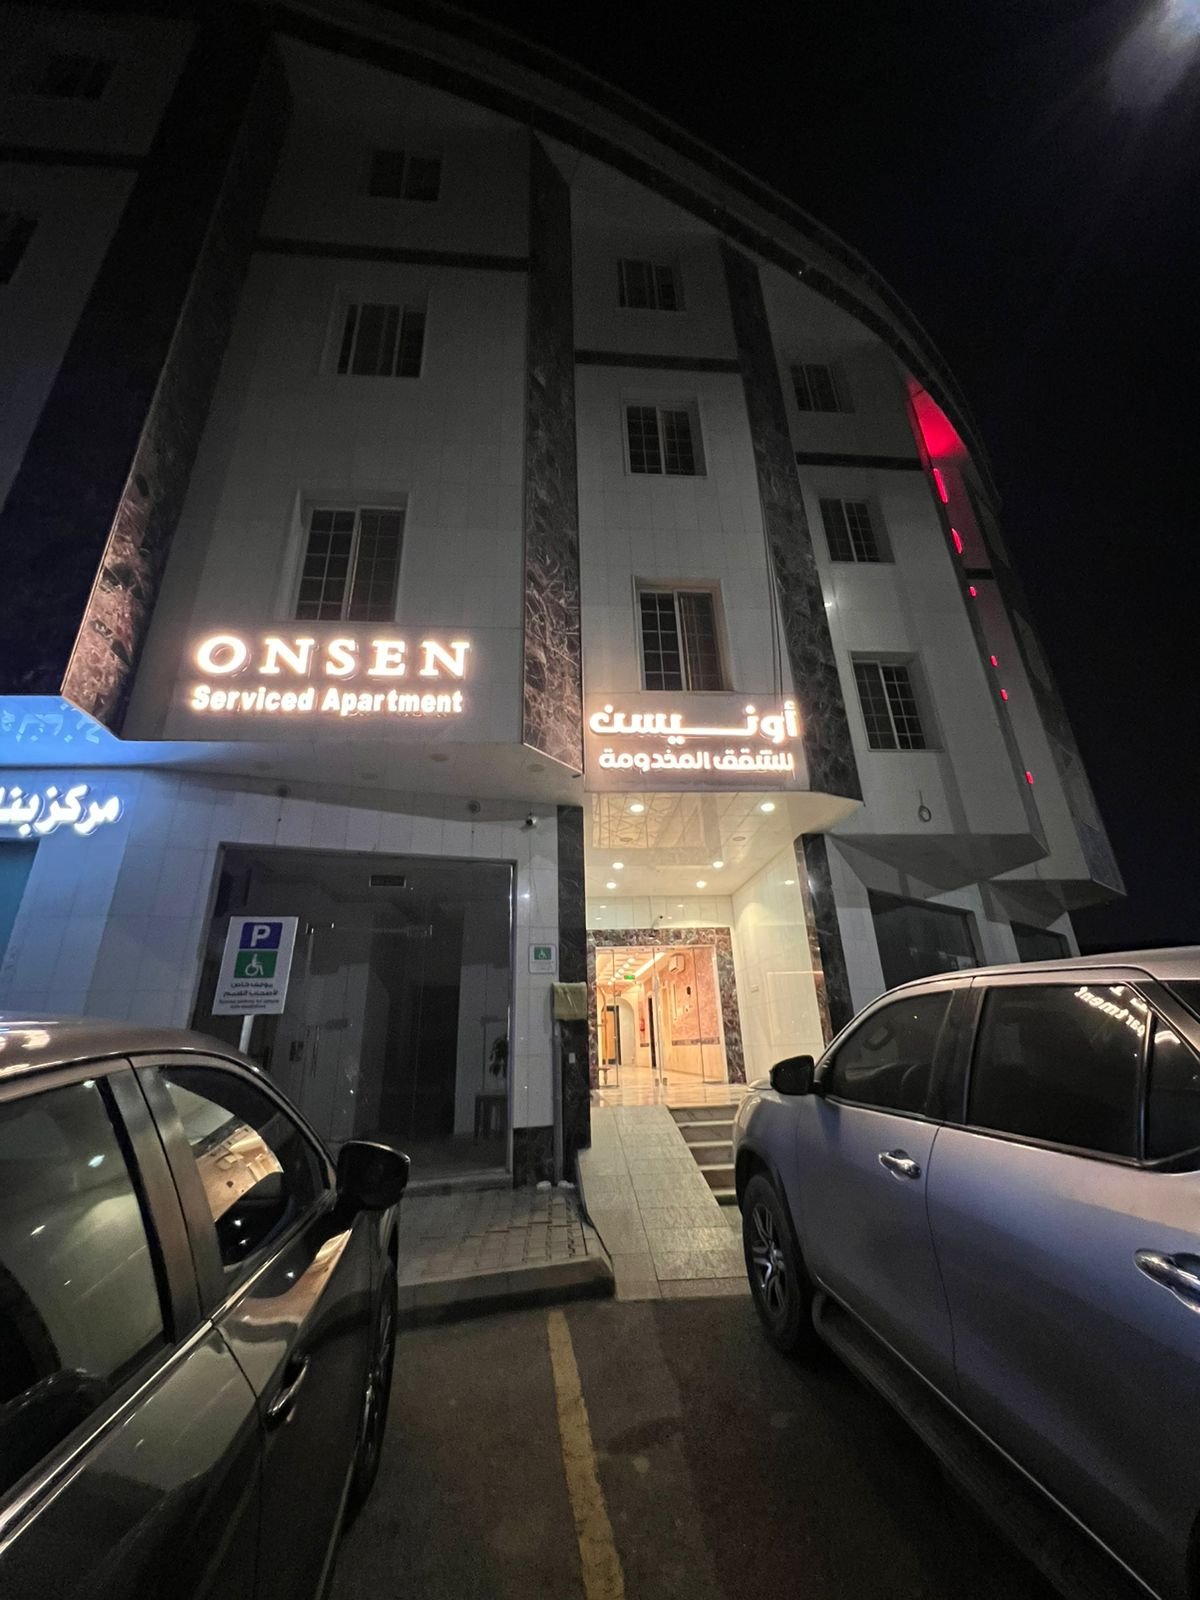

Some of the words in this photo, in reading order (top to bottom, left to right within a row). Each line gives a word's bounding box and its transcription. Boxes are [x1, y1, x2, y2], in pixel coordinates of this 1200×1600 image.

[196, 635, 471, 679] ONSEN
[190, 684, 315, 711] Serviced
[321, 687, 464, 716] Apartment
[598, 749, 712, 772] المخدومة
[713, 749, 794, 771] للشقق
[34, 784, 120, 833] مركز
[250, 924, 271, 947] P
